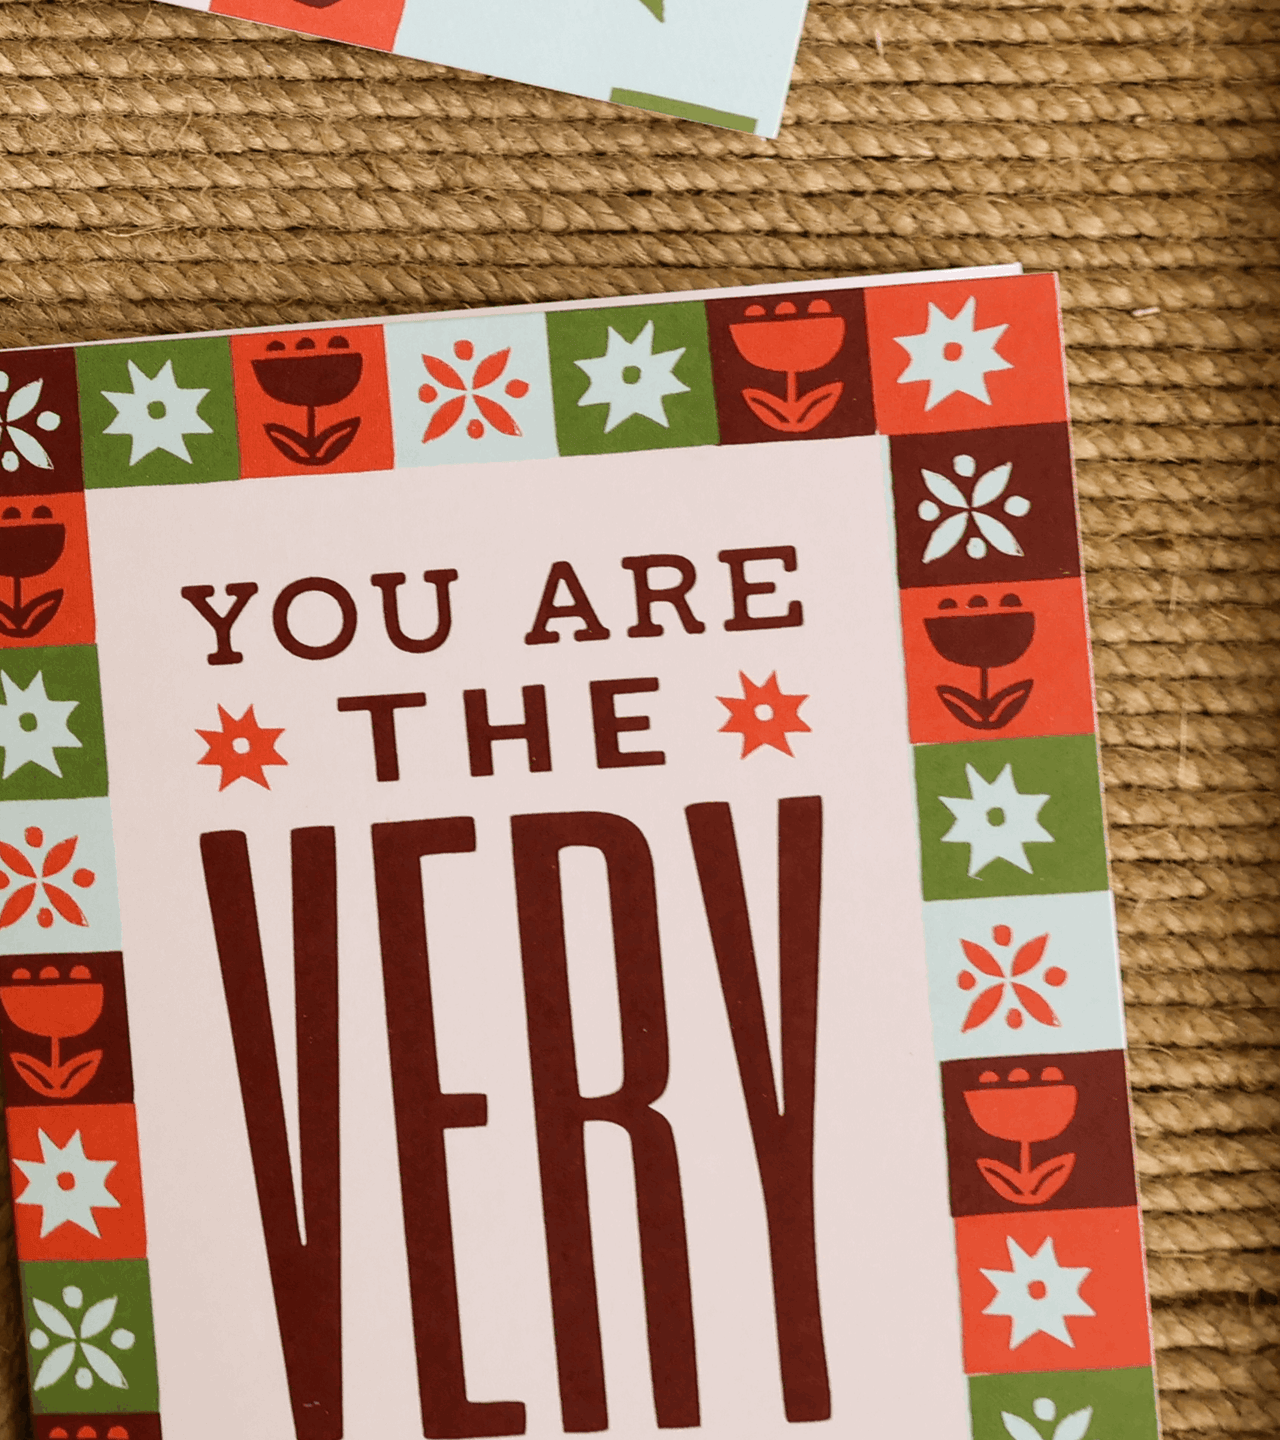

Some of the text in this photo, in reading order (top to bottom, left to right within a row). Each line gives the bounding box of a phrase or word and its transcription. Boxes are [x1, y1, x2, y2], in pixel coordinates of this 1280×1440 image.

[180, 544, 805, 667] YOU ARE
[336, 675, 667, 783] THE
[198, 793, 833, 1440] VERY
